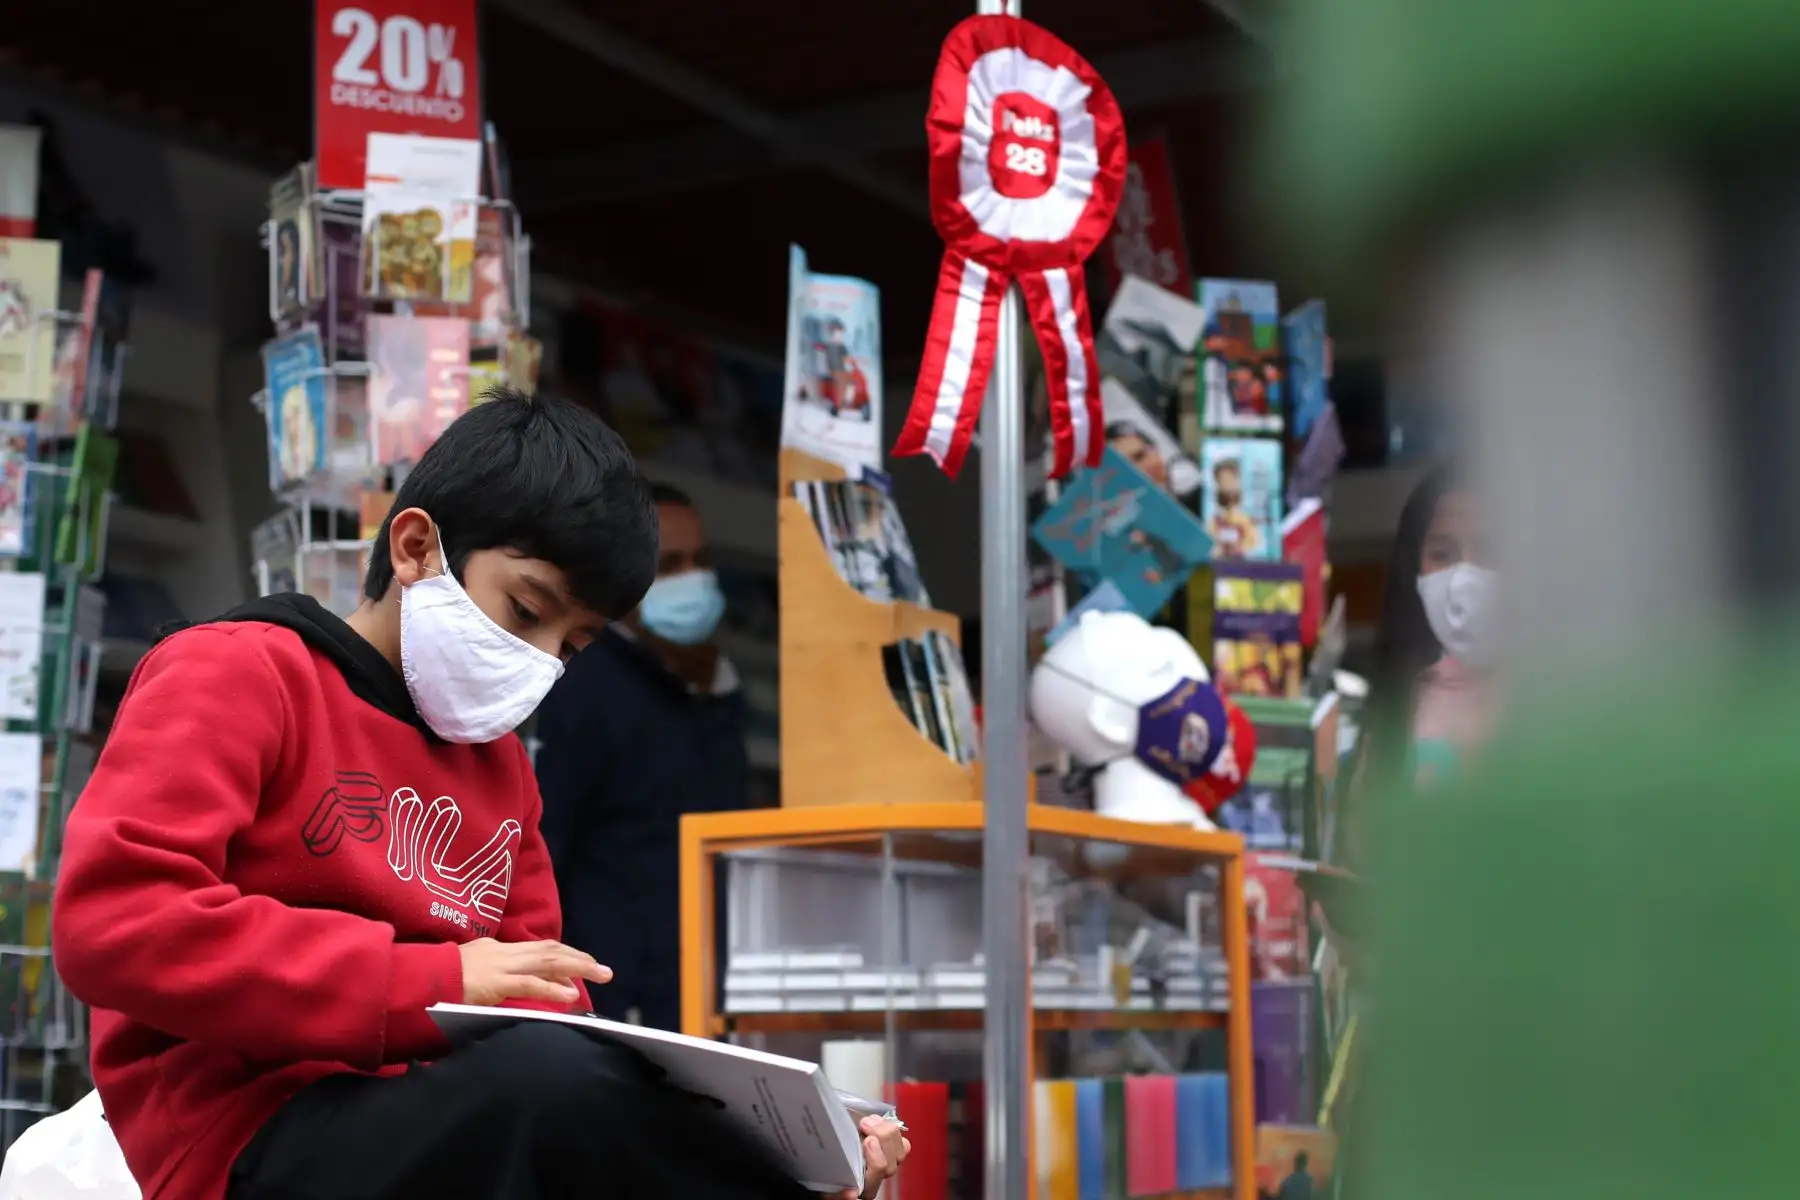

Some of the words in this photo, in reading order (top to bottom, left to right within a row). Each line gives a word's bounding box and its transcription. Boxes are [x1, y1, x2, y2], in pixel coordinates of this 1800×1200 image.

[332, 7, 464, 98] 20%
[331, 83, 464, 122] DESCUENTO
[1006, 143, 1047, 176] 28
[430, 901, 468, 928] SINCE
